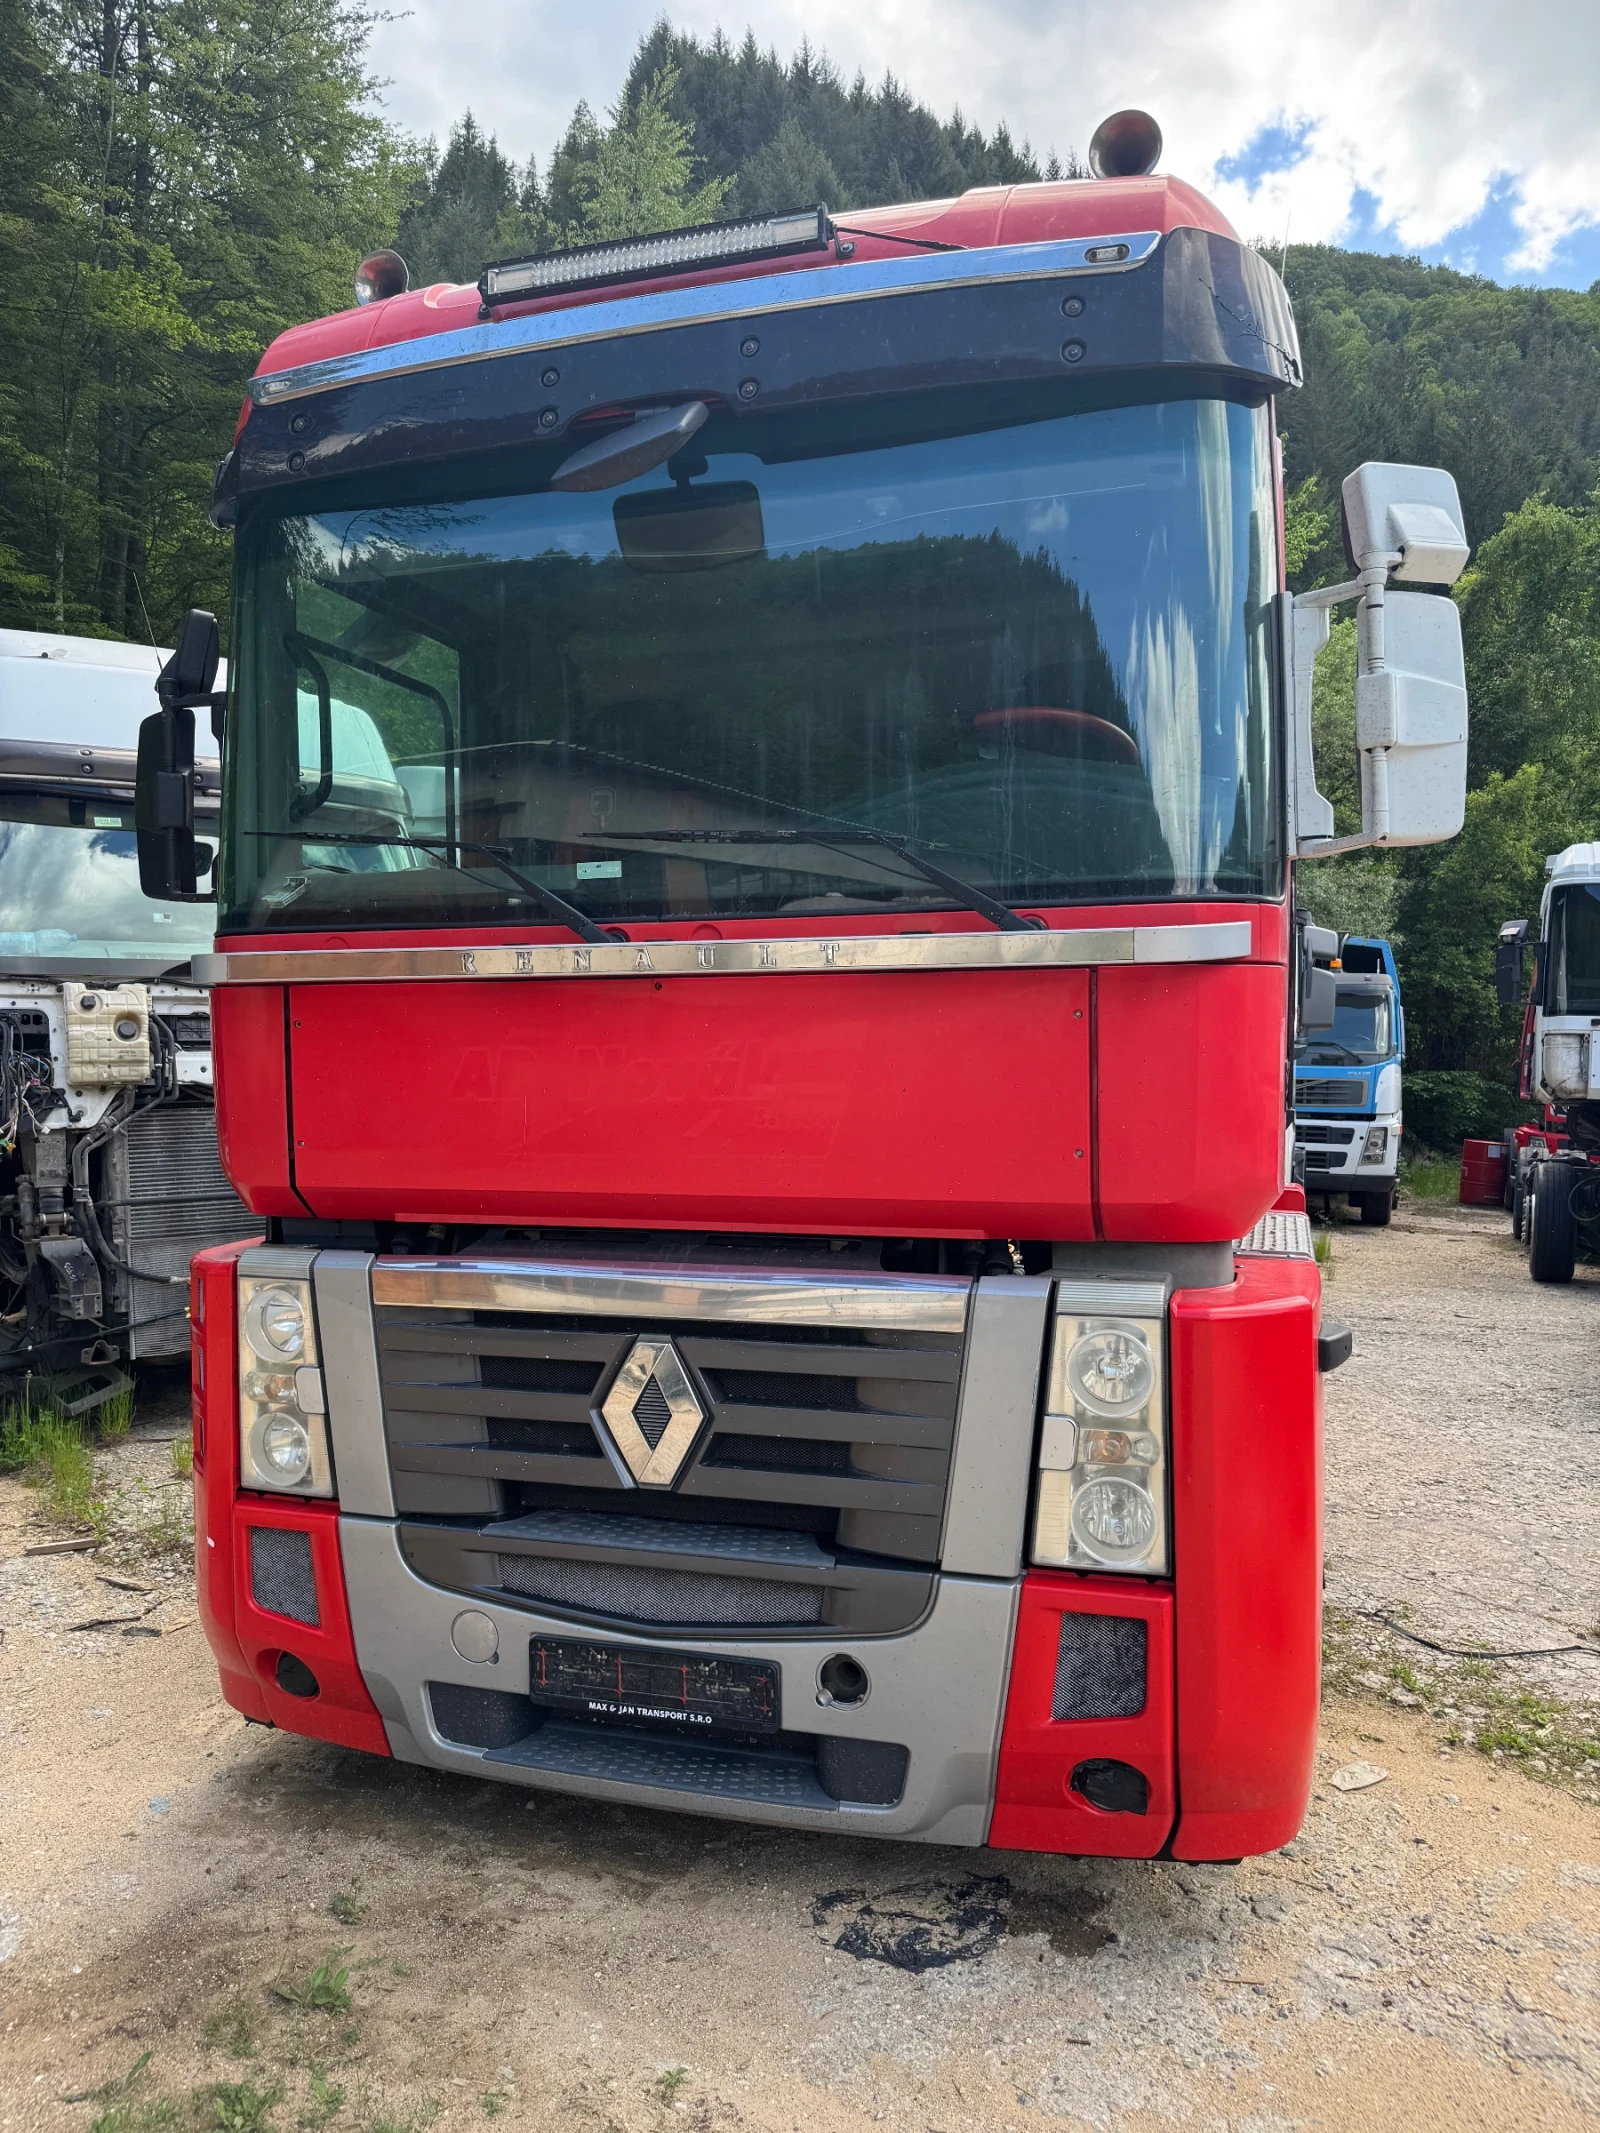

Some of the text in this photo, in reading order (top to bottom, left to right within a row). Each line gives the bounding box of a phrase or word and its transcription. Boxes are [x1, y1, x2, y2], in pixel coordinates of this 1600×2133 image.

[457, 943, 840, 973] RENAULT
[588, 1701, 713, 1724] MAX & JAN TRANSPORT S.R.O
